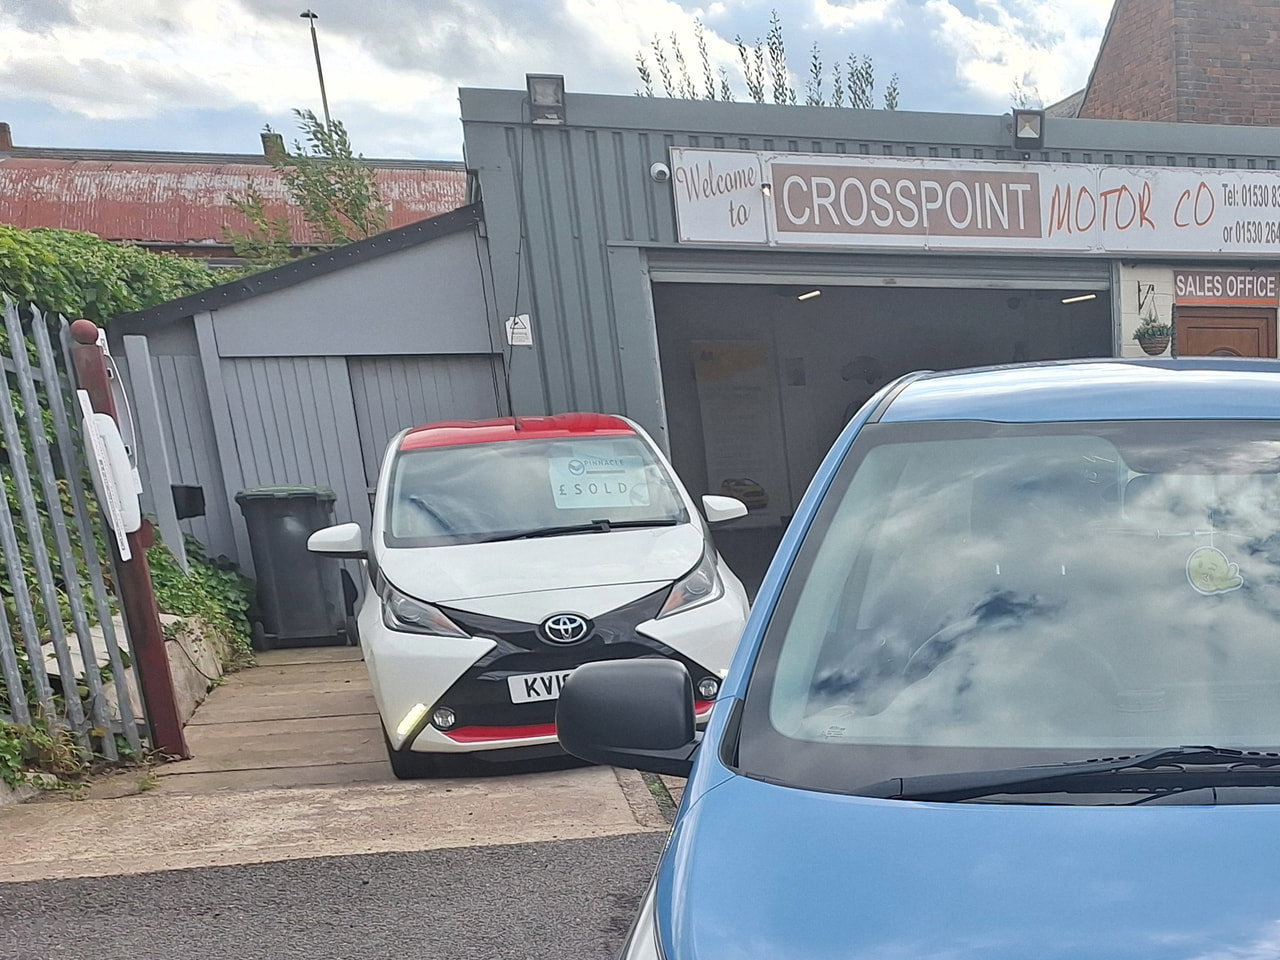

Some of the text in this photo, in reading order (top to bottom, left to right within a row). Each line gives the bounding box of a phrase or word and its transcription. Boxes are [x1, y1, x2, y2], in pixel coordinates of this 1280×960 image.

[676, 160, 756, 202] Welcome
[1222, 183, 1239, 207] Tel:
[1241, 184, 1269, 208] 01530
[728, 200, 750, 229] to
[782, 174, 1031, 230] CROSSPOINT
[1049, 181, 1215, 238] MOTOR CO
[1223, 226, 1233, 243] or
[1235, 220, 1263, 244] 01530
[1175, 275, 1276, 298] SALES OFFICE
